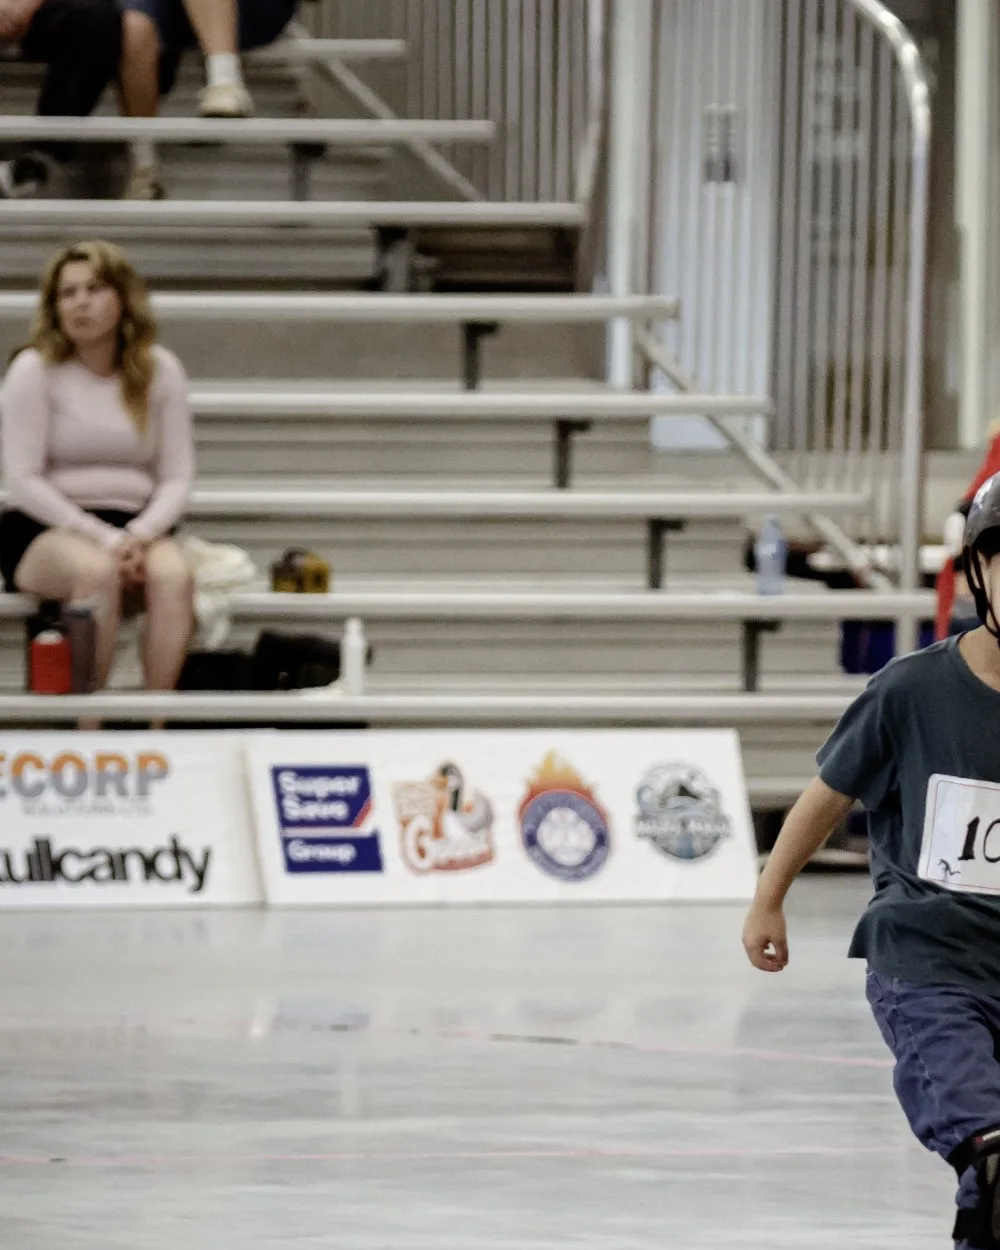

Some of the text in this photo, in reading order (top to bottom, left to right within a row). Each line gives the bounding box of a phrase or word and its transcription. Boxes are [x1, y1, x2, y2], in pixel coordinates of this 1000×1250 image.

[0, 751, 169, 798] CORP
[279, 770, 360, 798] Super
[283, 796, 349, 821] Save
[0, 836, 210, 892] ullcandy
[287, 840, 358, 865] Group
